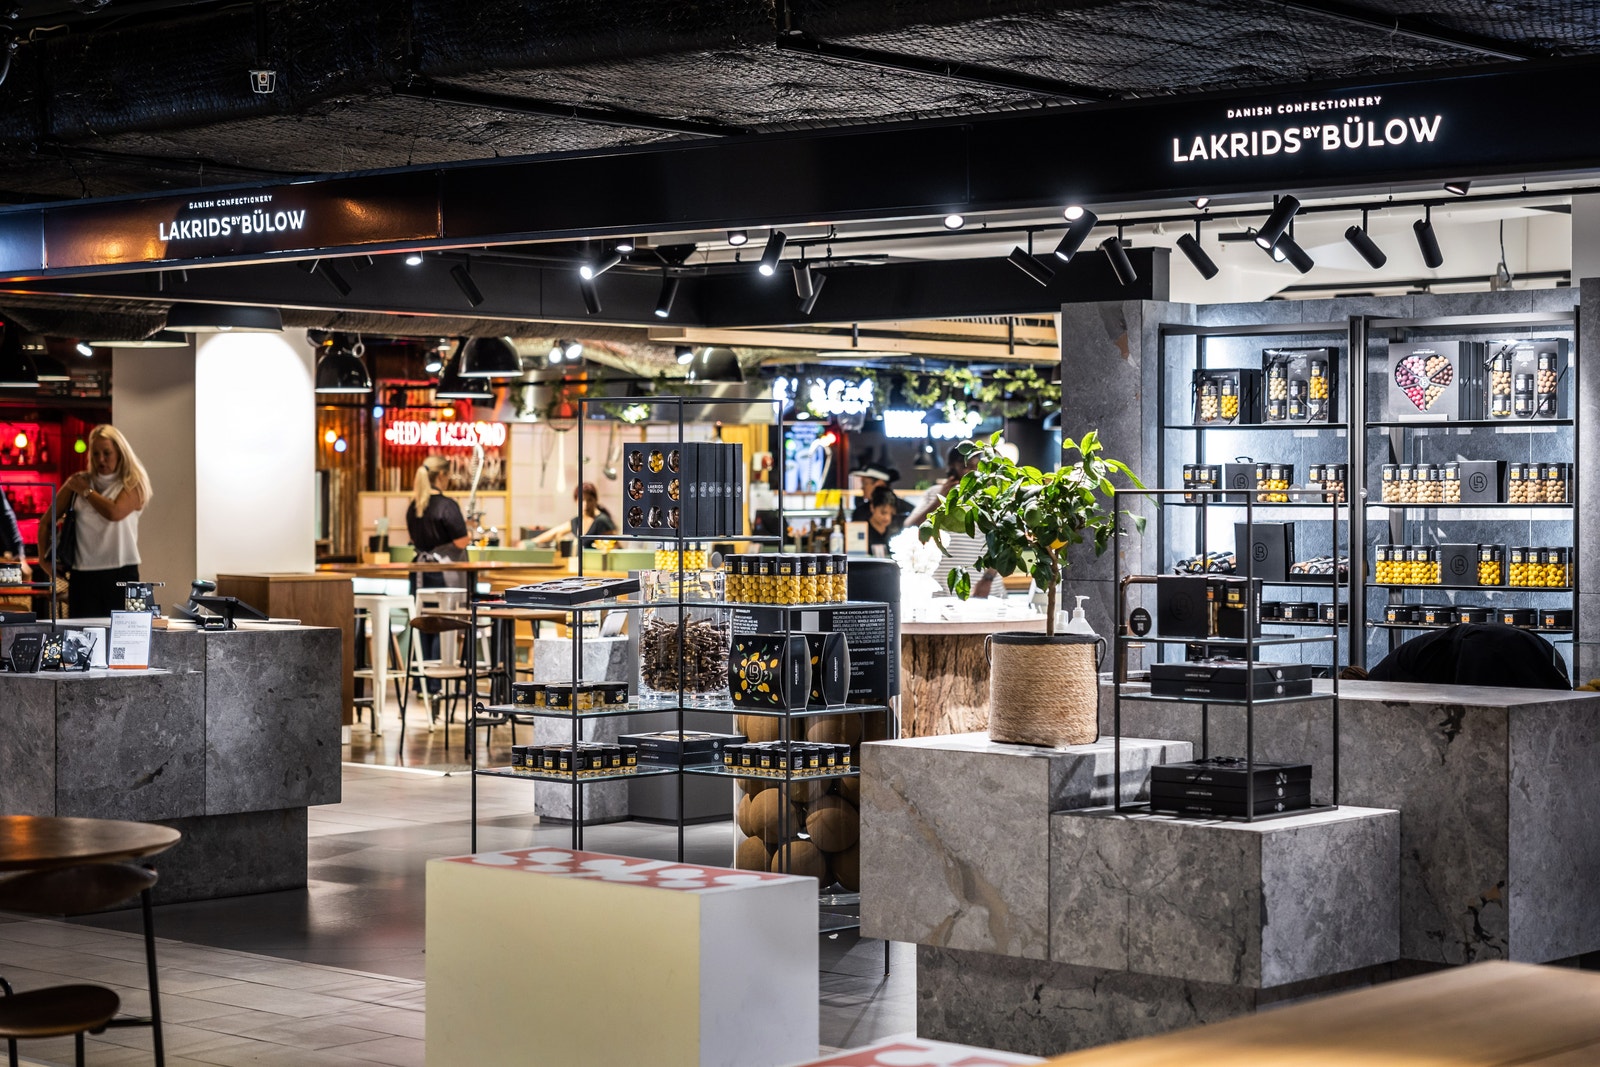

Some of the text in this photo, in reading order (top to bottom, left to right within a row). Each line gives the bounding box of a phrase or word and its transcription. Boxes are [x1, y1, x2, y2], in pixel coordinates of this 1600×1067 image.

[1227, 96, 1382, 118] DANISH CONFECTIONERY
[1173, 115, 1442, 162] LAKRIDS BY BÜLOW
[189, 195, 273, 209] DANISH CONFECTIONERY
[159, 209, 306, 241] LAKRIDS BY BÜLOW
